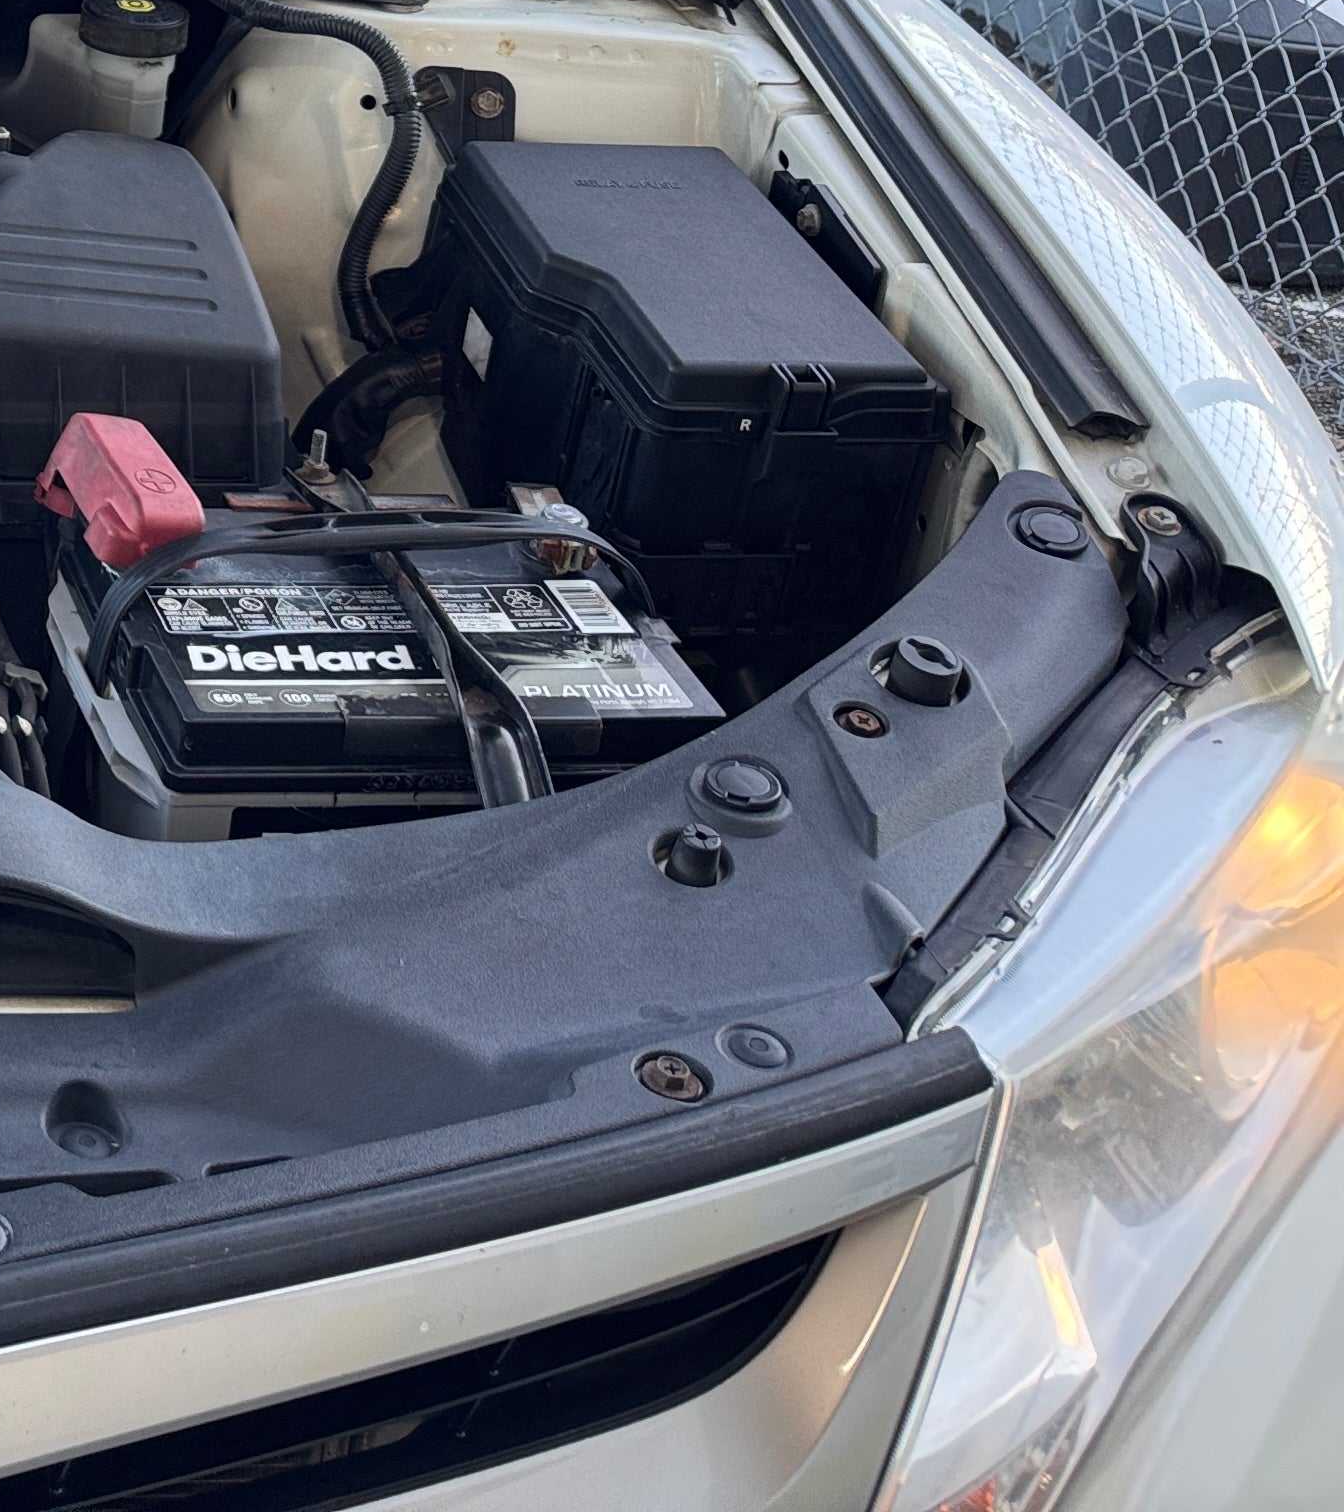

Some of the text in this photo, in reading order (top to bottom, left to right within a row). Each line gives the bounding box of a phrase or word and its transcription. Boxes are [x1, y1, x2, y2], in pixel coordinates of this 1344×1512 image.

[639, 178, 682, 190] FUSE
[739, 418, 752, 432] R
[176, 587, 302, 597] DANGER/POISON
[186, 644, 415, 672] DieHard
[523, 683, 673, 698] PLATINUM
